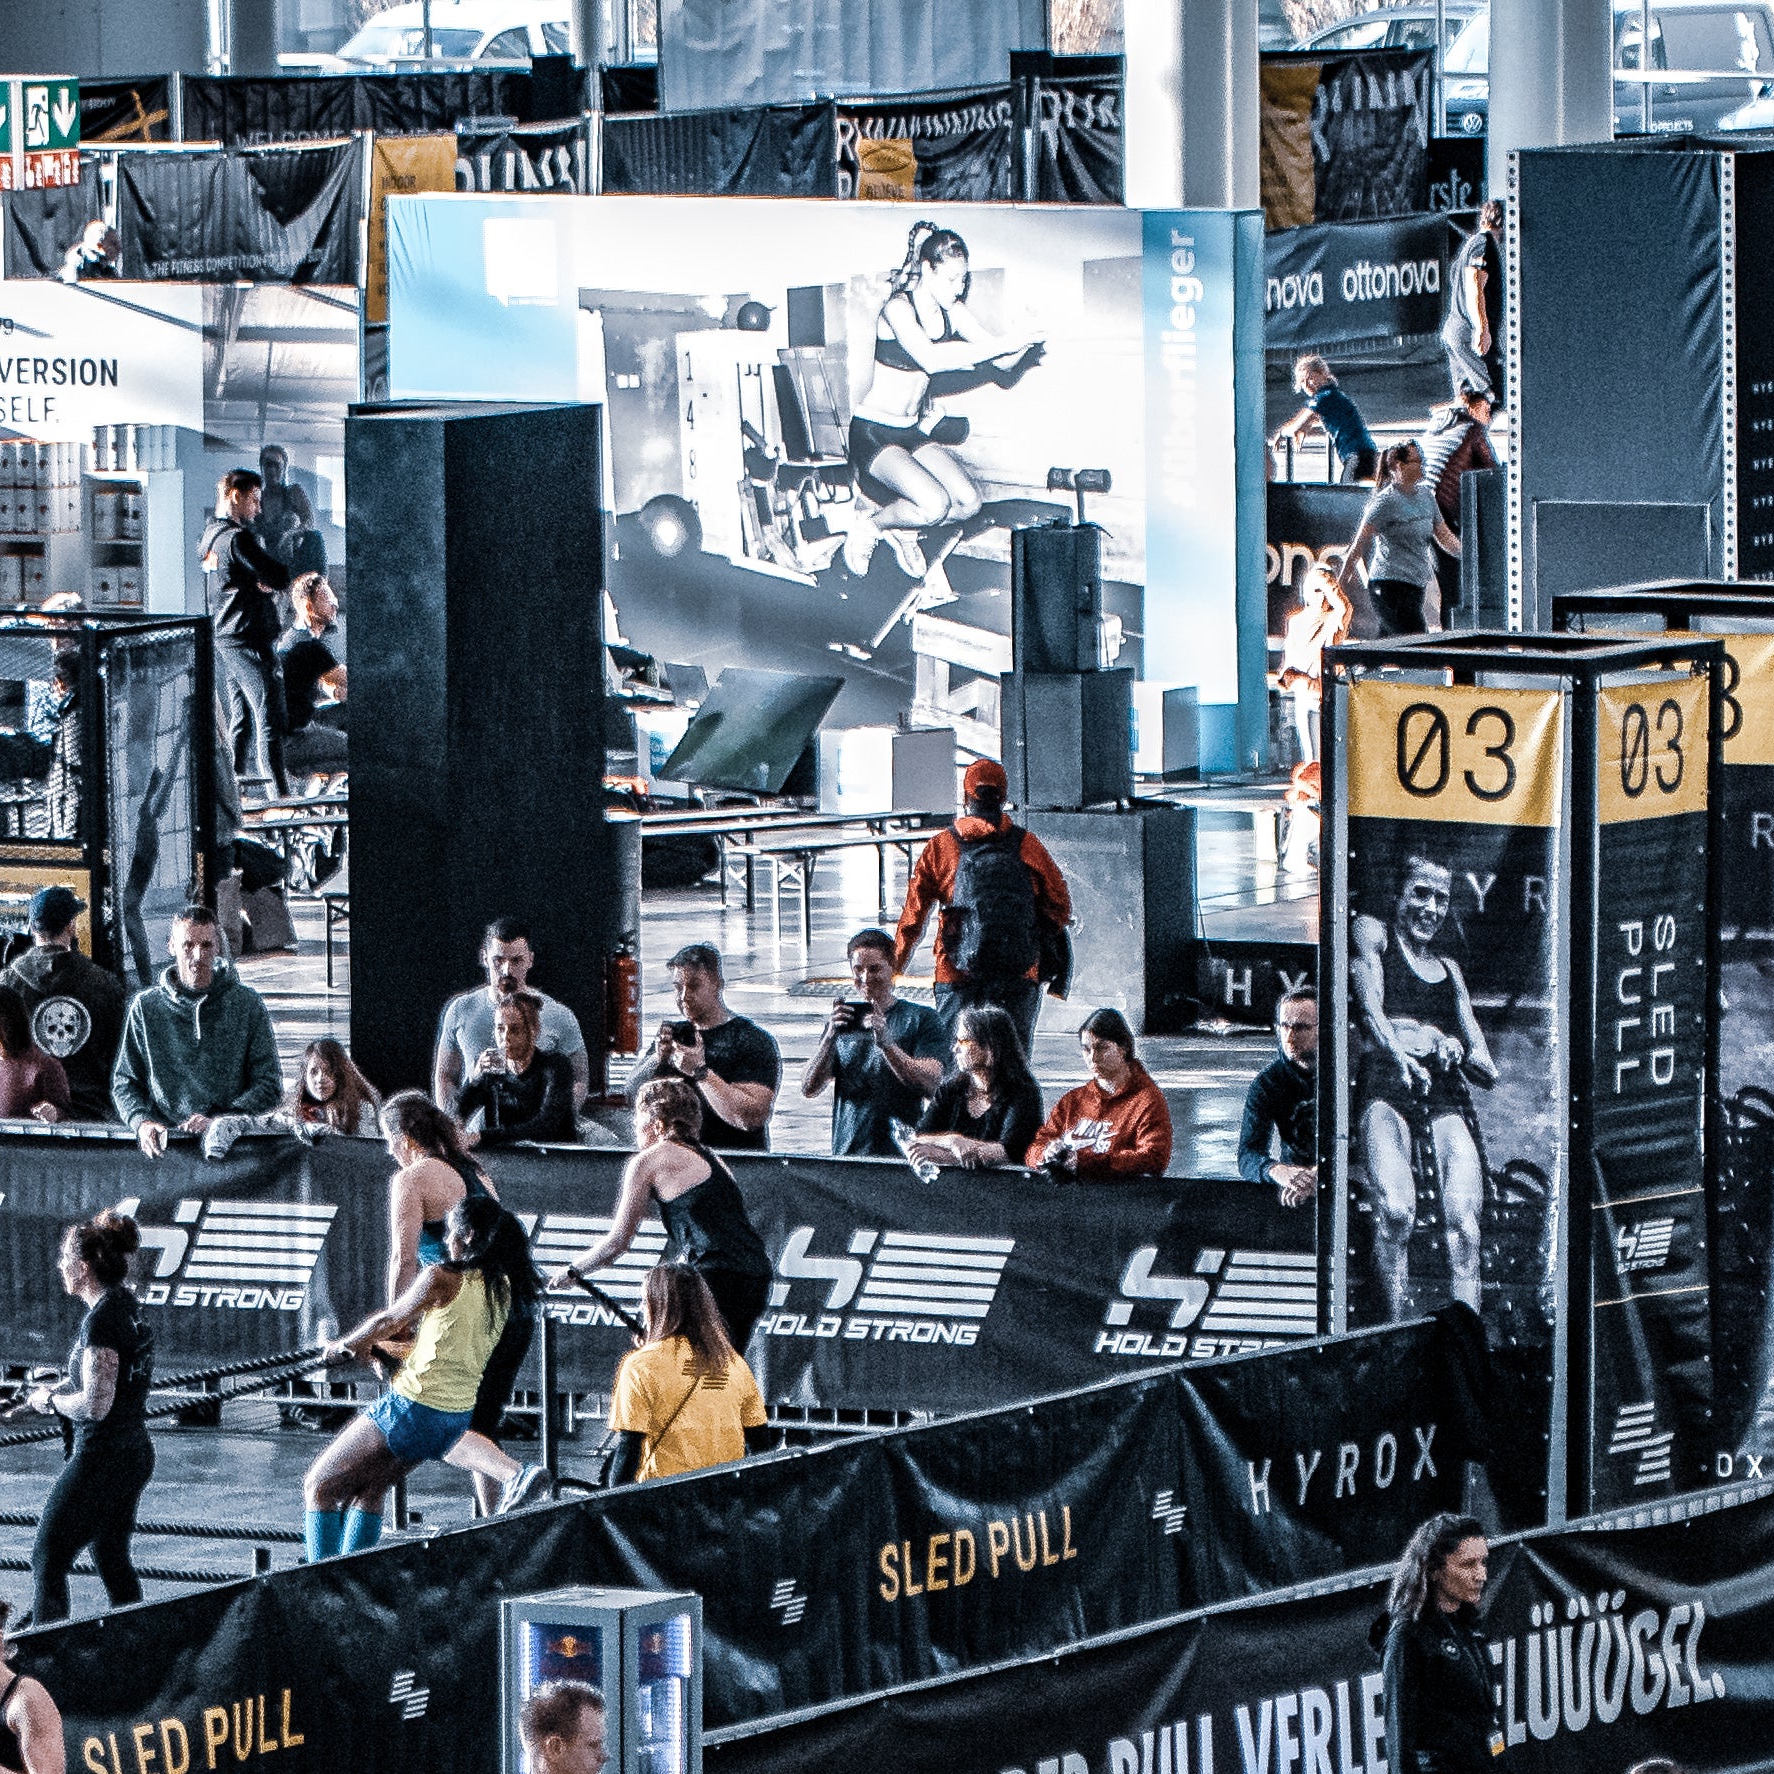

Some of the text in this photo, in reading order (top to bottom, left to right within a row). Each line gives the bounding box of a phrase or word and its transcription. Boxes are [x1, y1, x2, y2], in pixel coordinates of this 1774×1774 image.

[1342, 258, 1442, 302] ottonova
[1395, 702, 1518, 802] 03
[1620, 698, 1685, 800] 03
[1615, 920, 1643, 1096] PULL
[1651, 912, 1677, 1090] SLED
[174, 1286, 306, 1312] STRONG
[757, 1316, 980, 1346] HOLD STRONG
[1095, 1330, 1183, 1355] HOLD
[1247, 1422, 1438, 1517] HYROX
[878, 1504, 1079, 1603] SLED PULL
[203, 1687, 306, 1772] PULL
